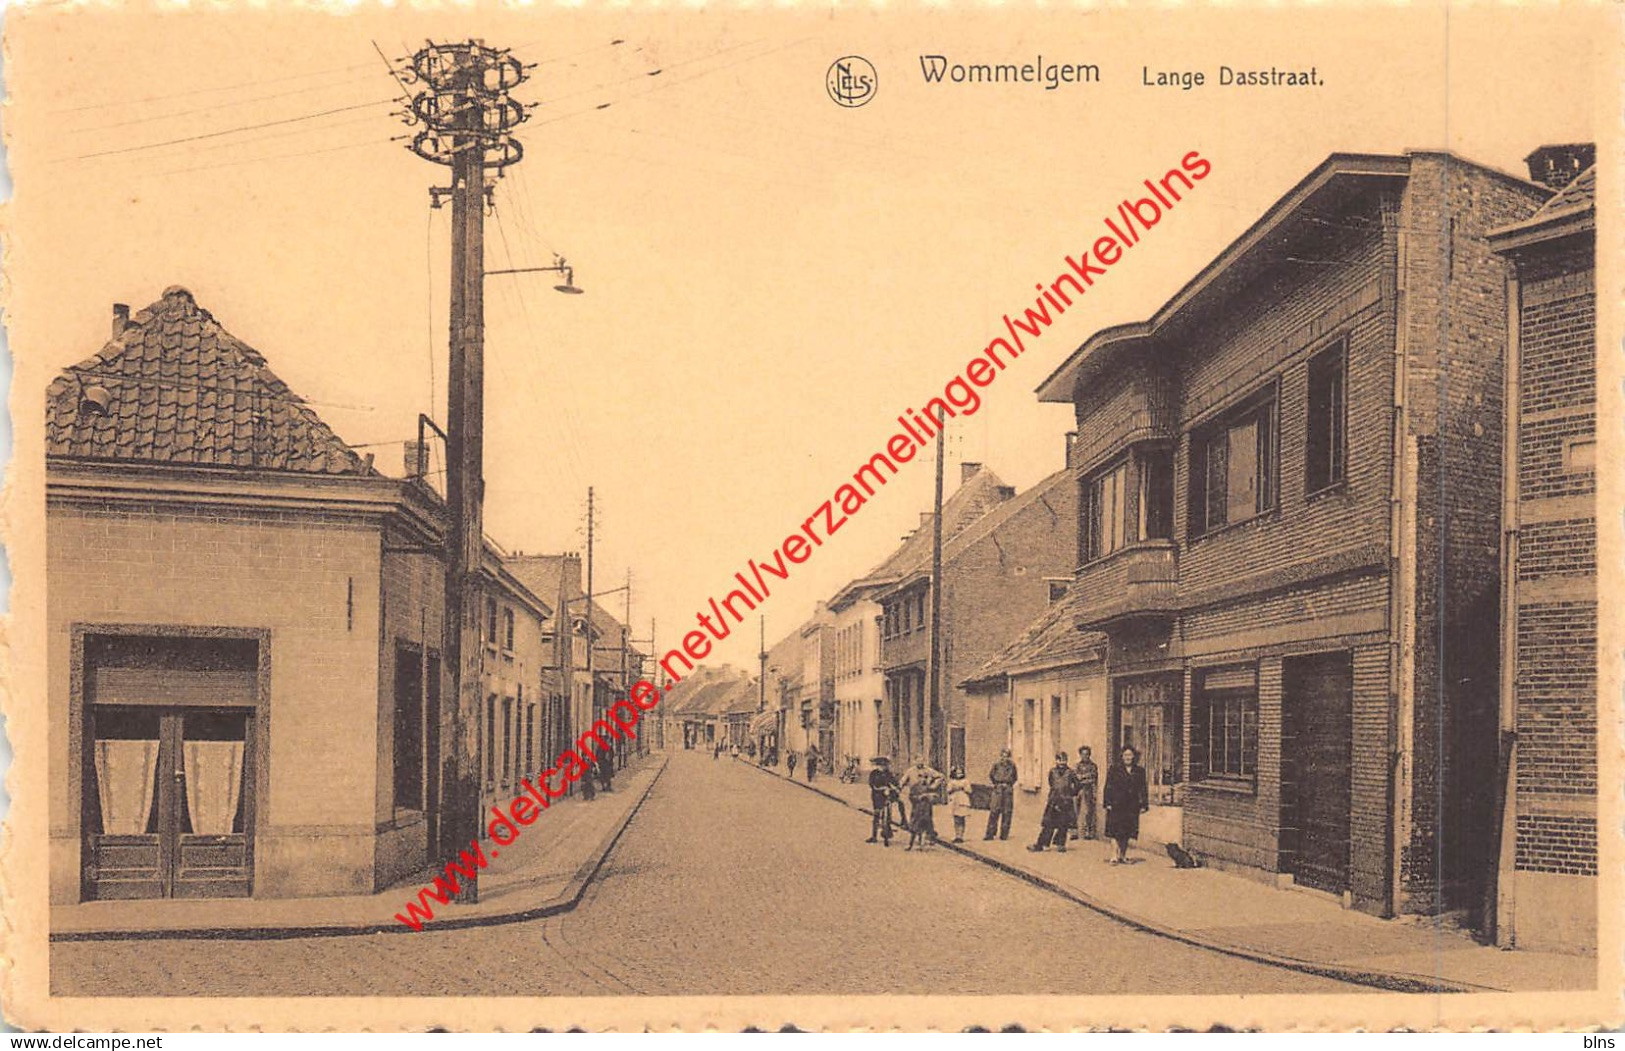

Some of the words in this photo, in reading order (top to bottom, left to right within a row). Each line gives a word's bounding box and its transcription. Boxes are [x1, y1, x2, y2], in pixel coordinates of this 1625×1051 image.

[919, 54, 1100, 90] Wommelgem
[1142, 66, 1205, 91] Lange
[1218, 65, 1324, 86] Dasstraat.
